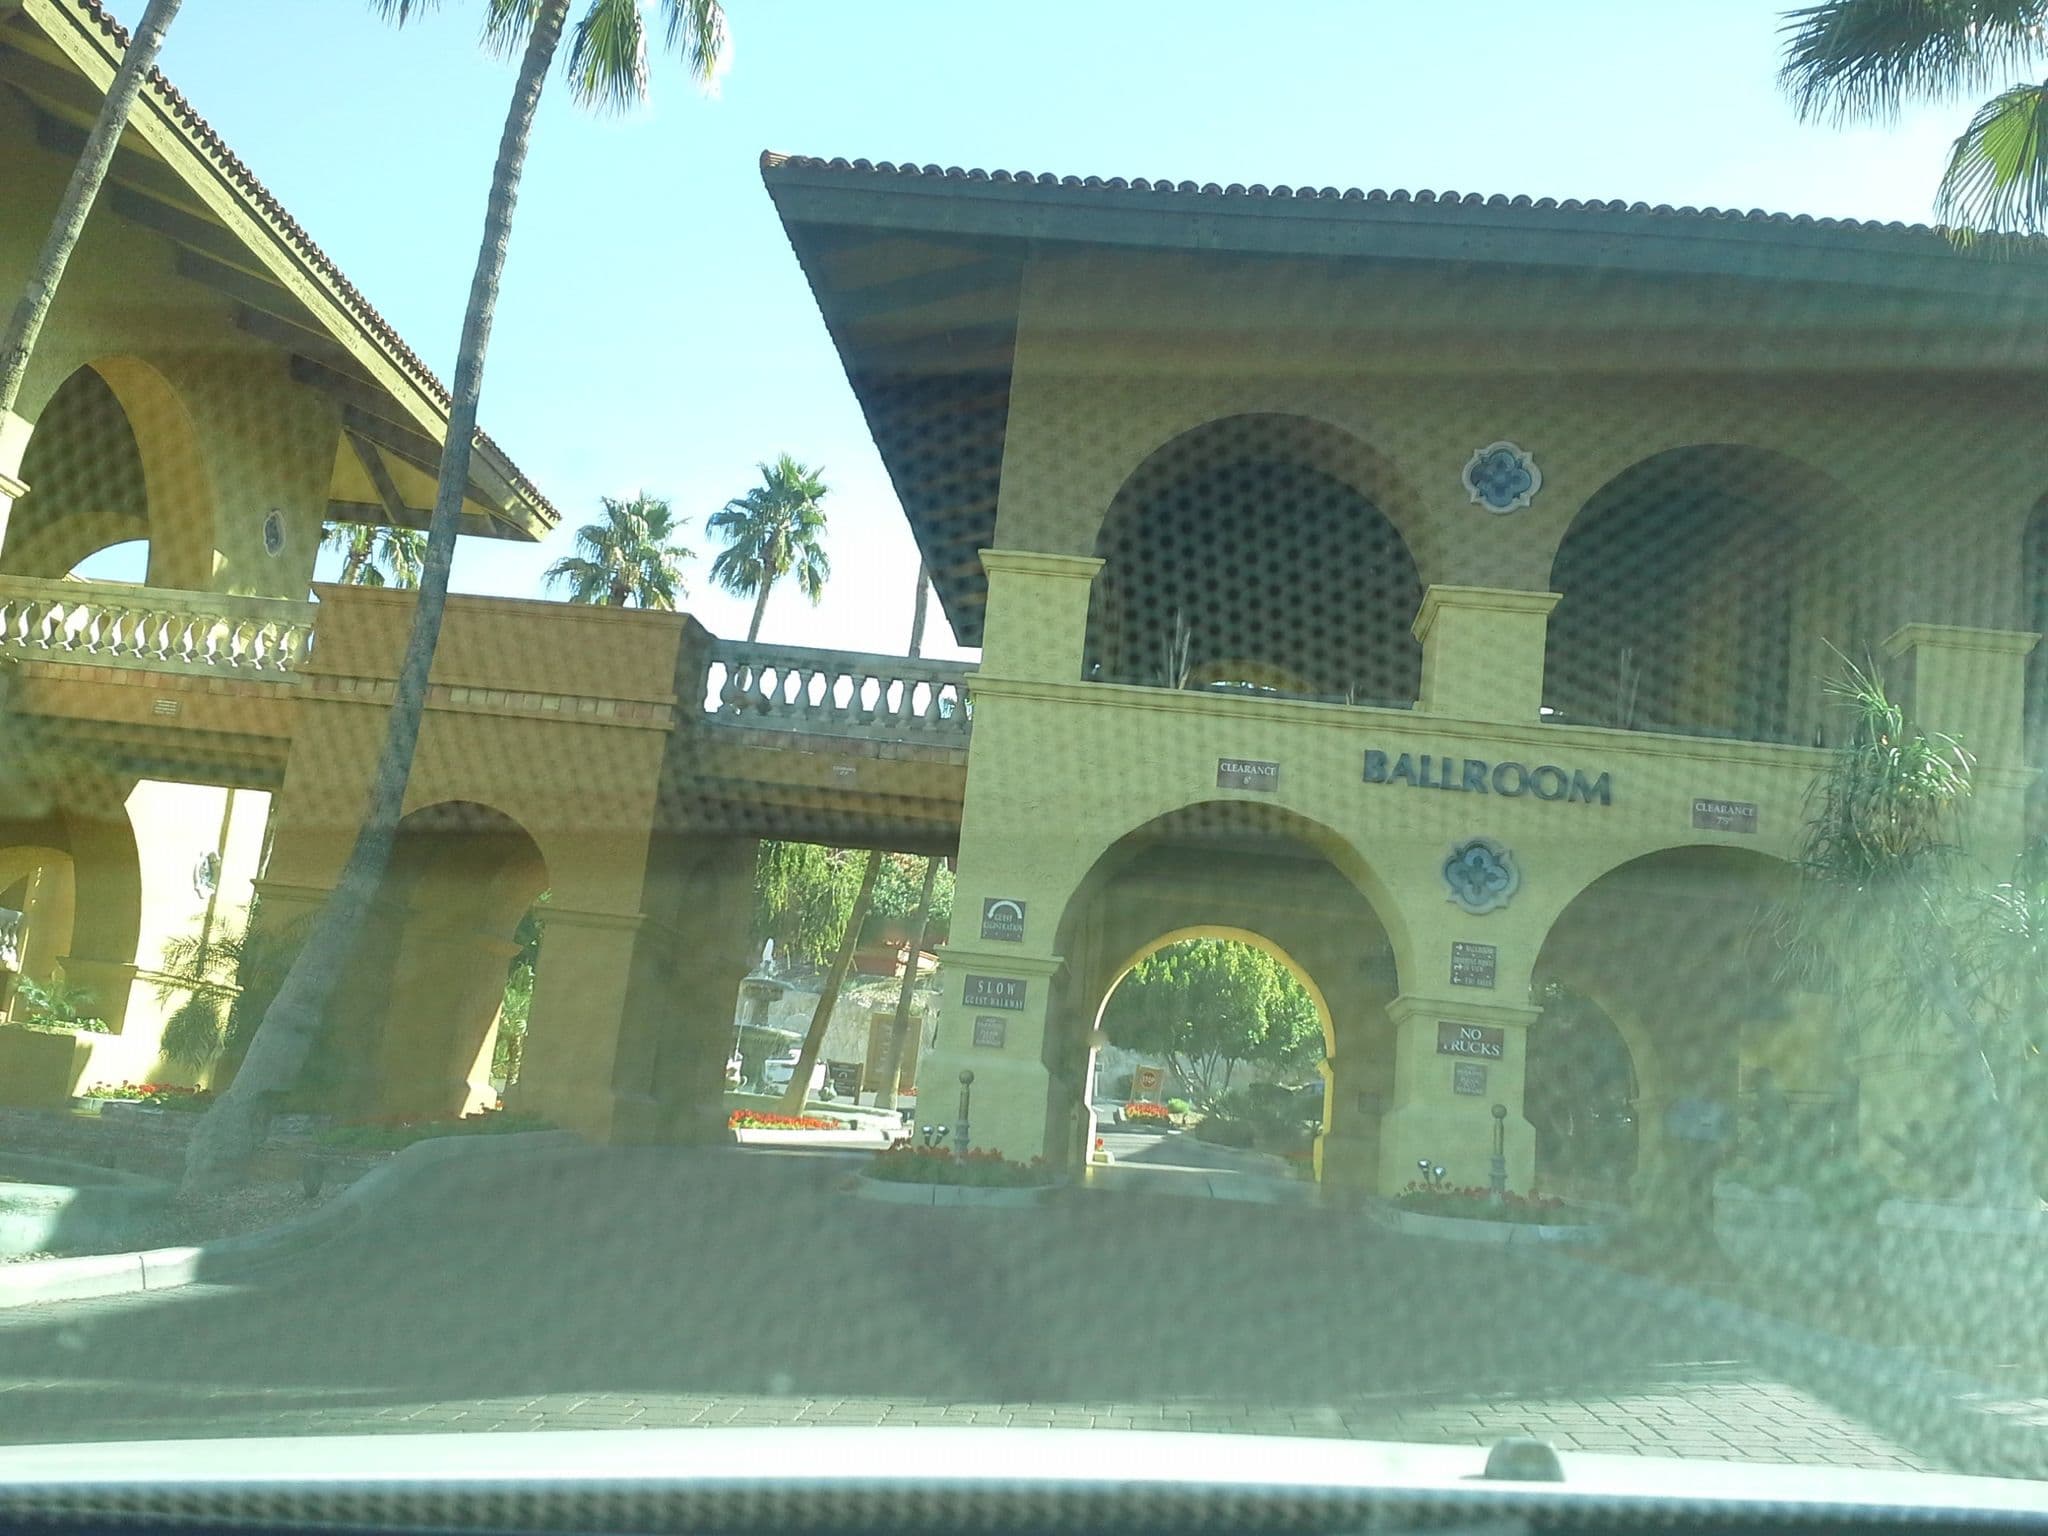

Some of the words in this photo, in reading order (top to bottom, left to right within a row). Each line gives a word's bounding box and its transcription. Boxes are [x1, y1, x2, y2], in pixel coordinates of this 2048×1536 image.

[1220, 762, 1277, 776] CLEARANCE
[1362, 749, 1610, 806] BALLROOM
[1695, 802, 1753, 816] CLEARANCE
[977, 980, 1017, 996] SLOW
[965, 995, 988, 1005] GUEST
[990, 997, 1023, 1009] WALKWAY
[1460, 1026, 1482, 1041] NO
